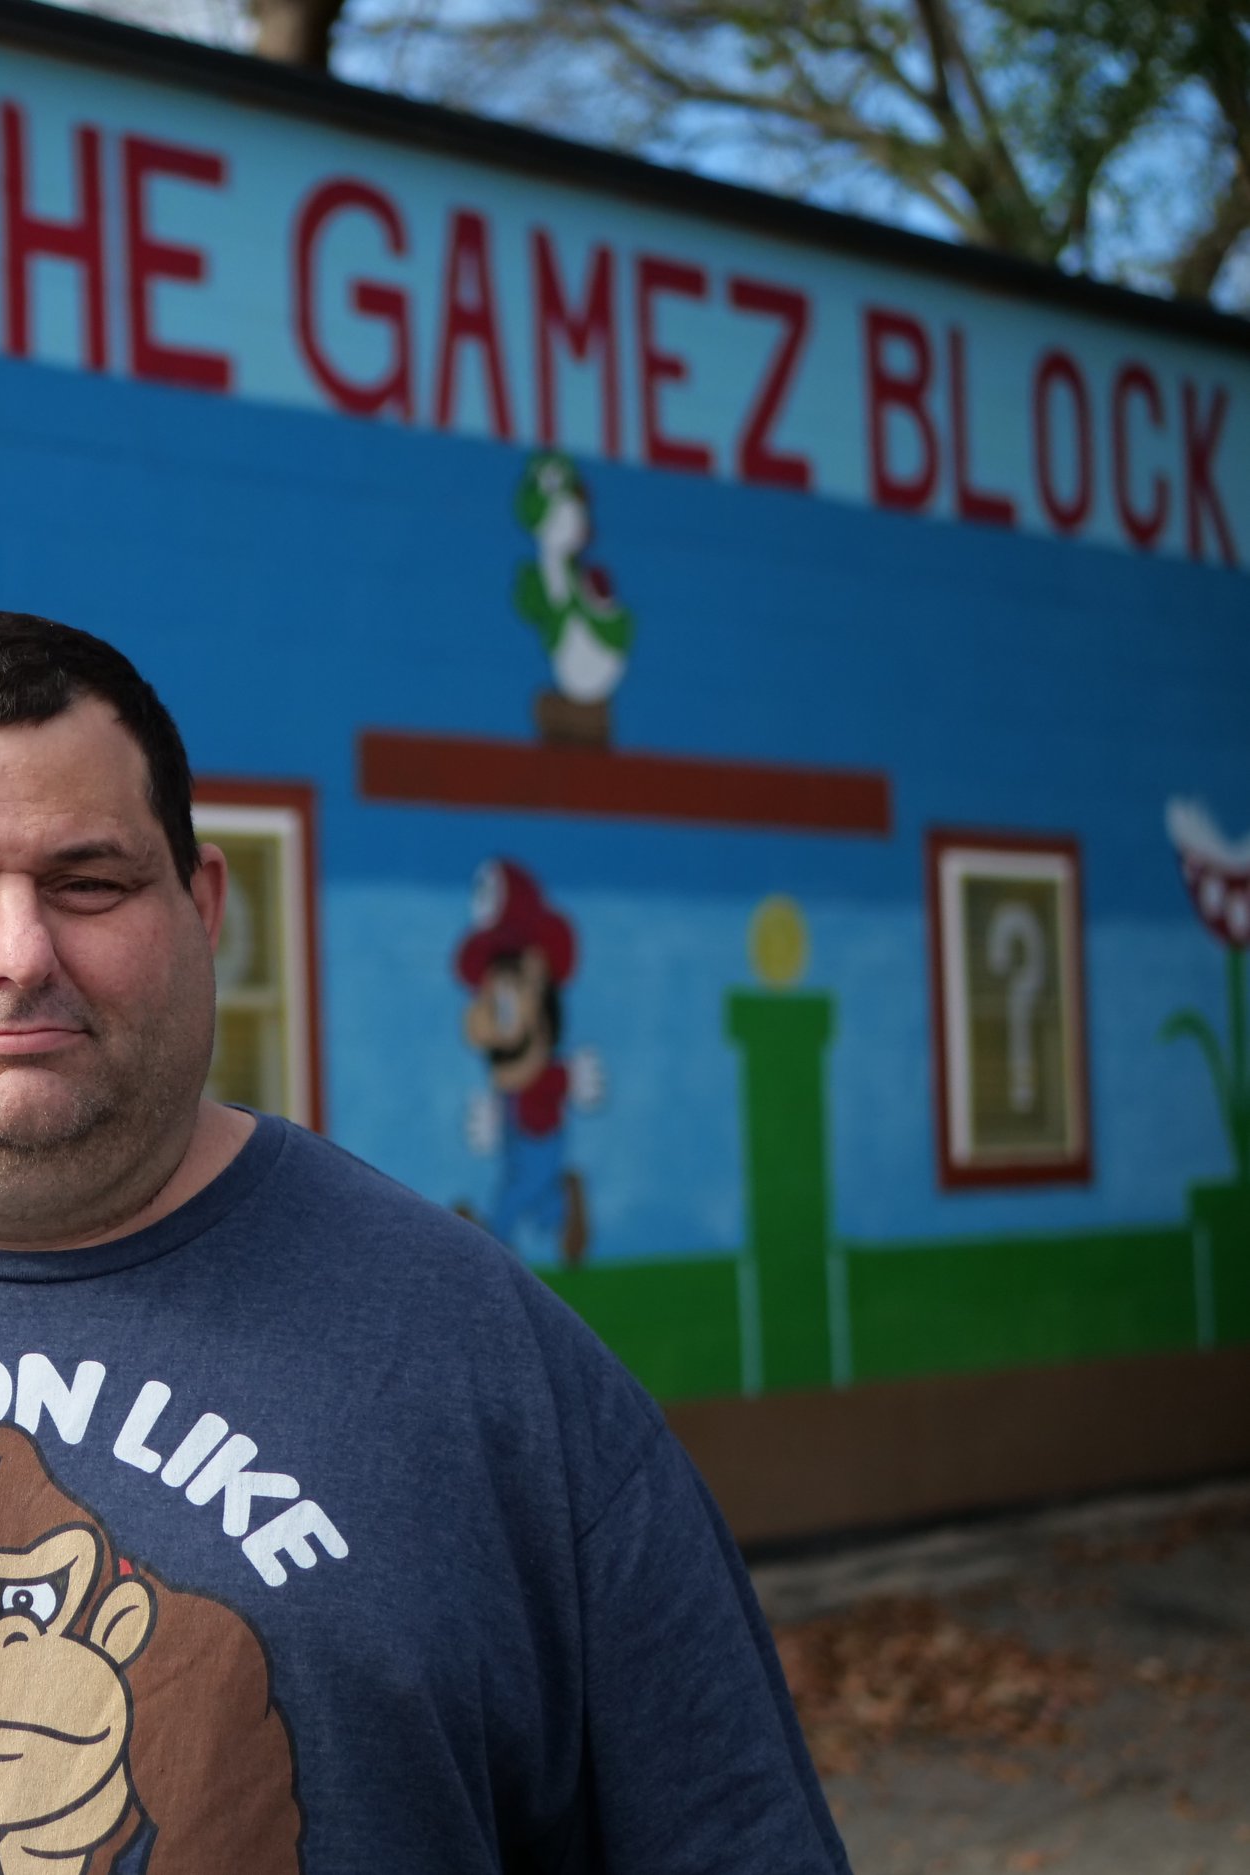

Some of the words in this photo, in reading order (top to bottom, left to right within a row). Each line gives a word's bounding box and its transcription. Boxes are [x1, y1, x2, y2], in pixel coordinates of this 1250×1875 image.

[289, 175, 813, 492] GAMEZ
[861, 303, 1239, 567] BLOCK
[112, 1380, 349, 1587] LIKE
